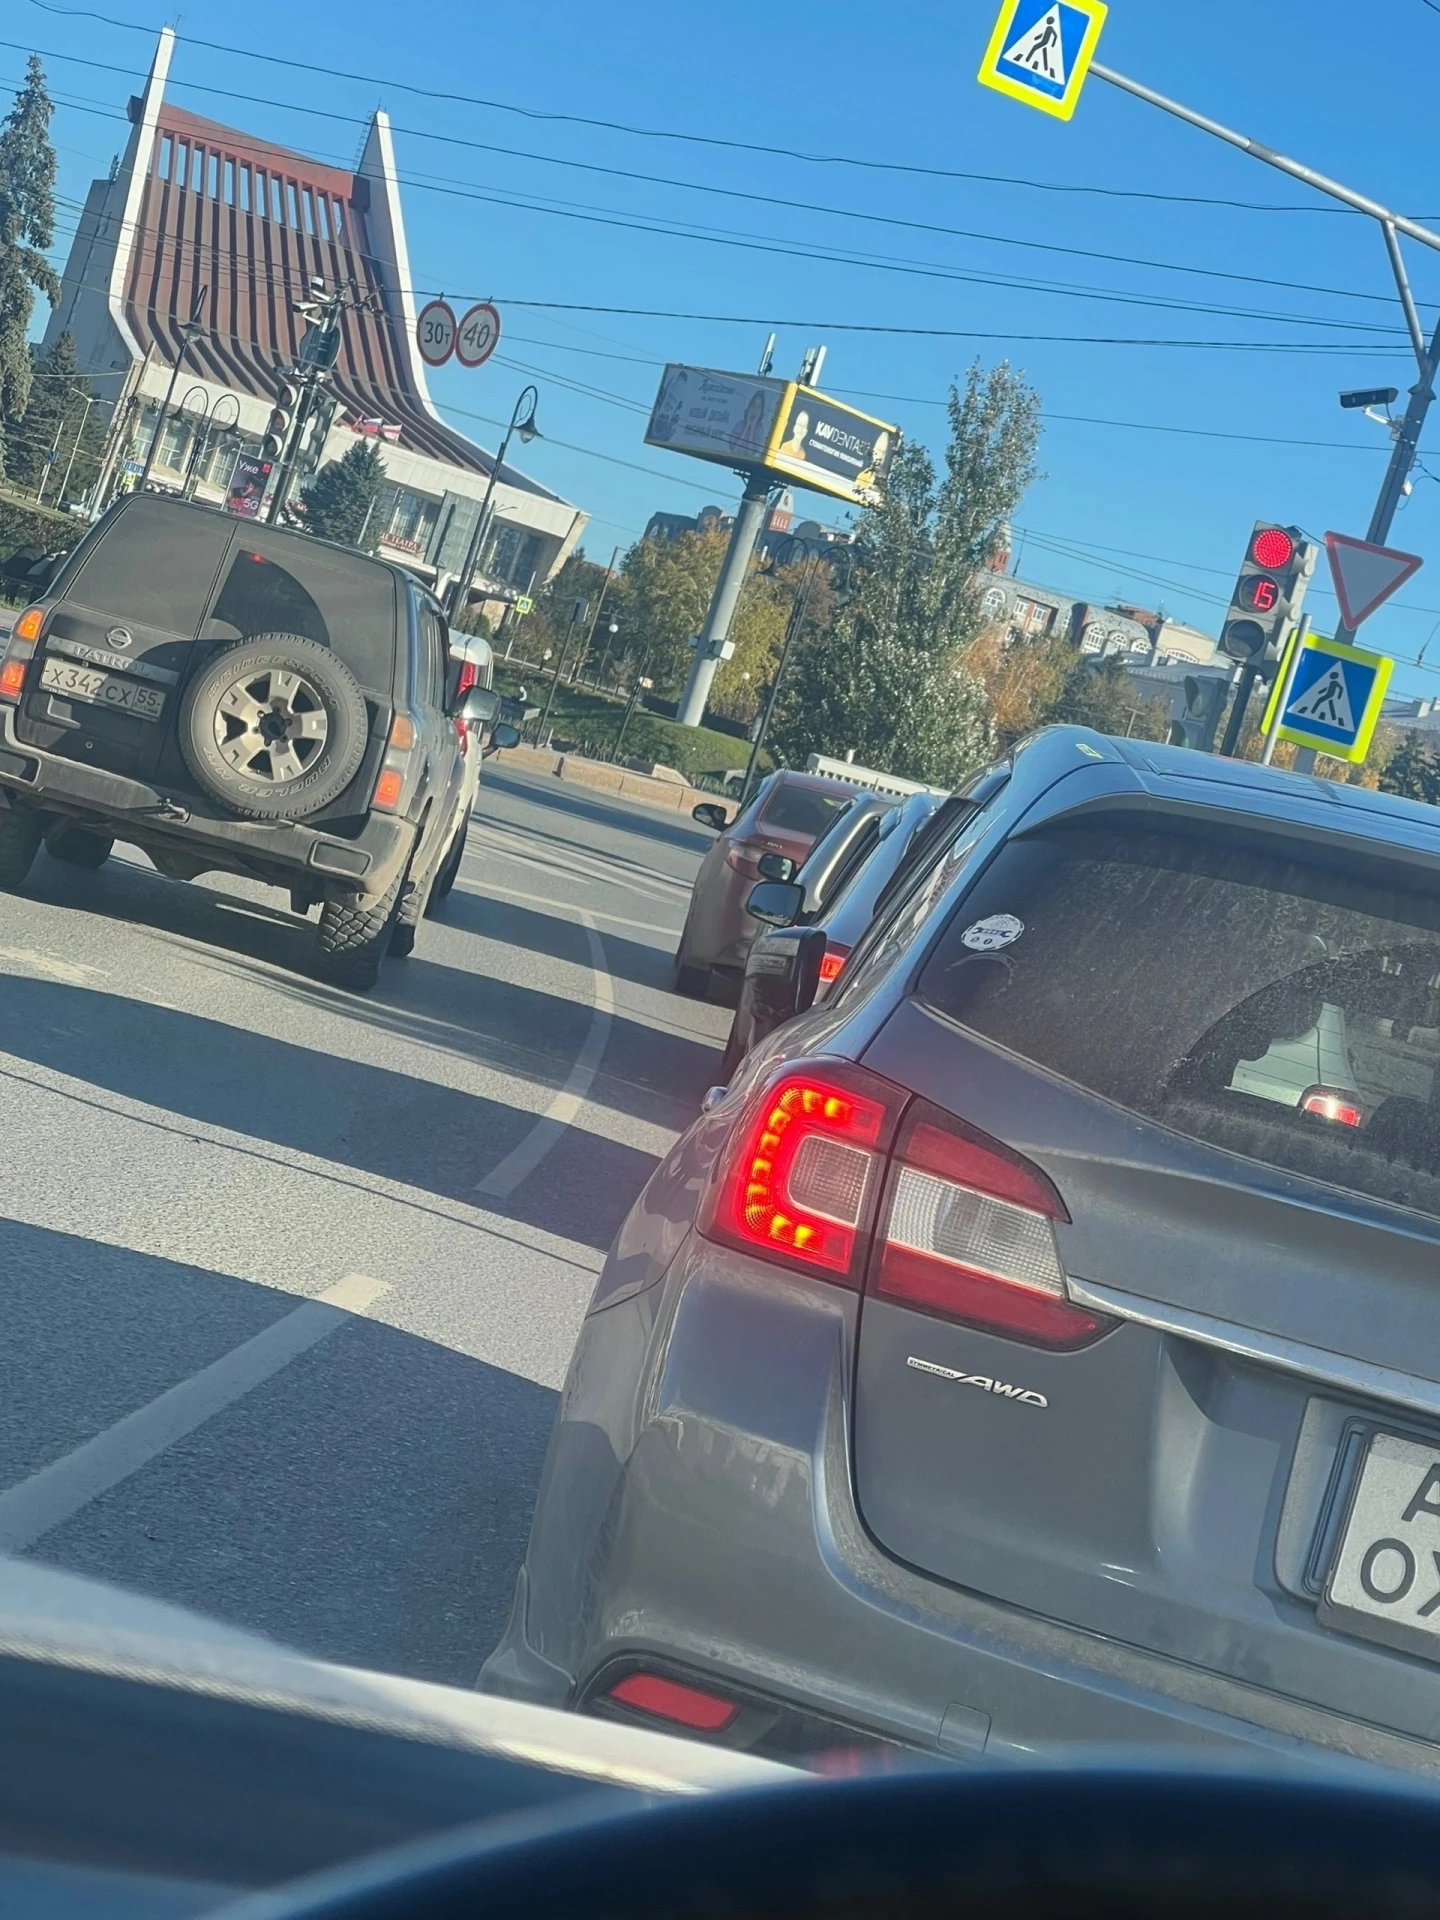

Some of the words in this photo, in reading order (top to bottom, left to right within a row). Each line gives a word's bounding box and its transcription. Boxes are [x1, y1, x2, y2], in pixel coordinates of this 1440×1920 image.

[462, 322, 490, 349] 40
[239, 460, 259, 474] Уже
[243, 498, 259, 510] 5G
[1253, 582, 1276, 609] 15
[75, 645, 150, 677] PATROL
[137, 688, 158, 706] 55
[207, 655, 341, 712] BRIDGESTONE
[908, 1358, 957, 1379] SYMMETRICAL
[957, 1374, 1049, 1408] AWD
